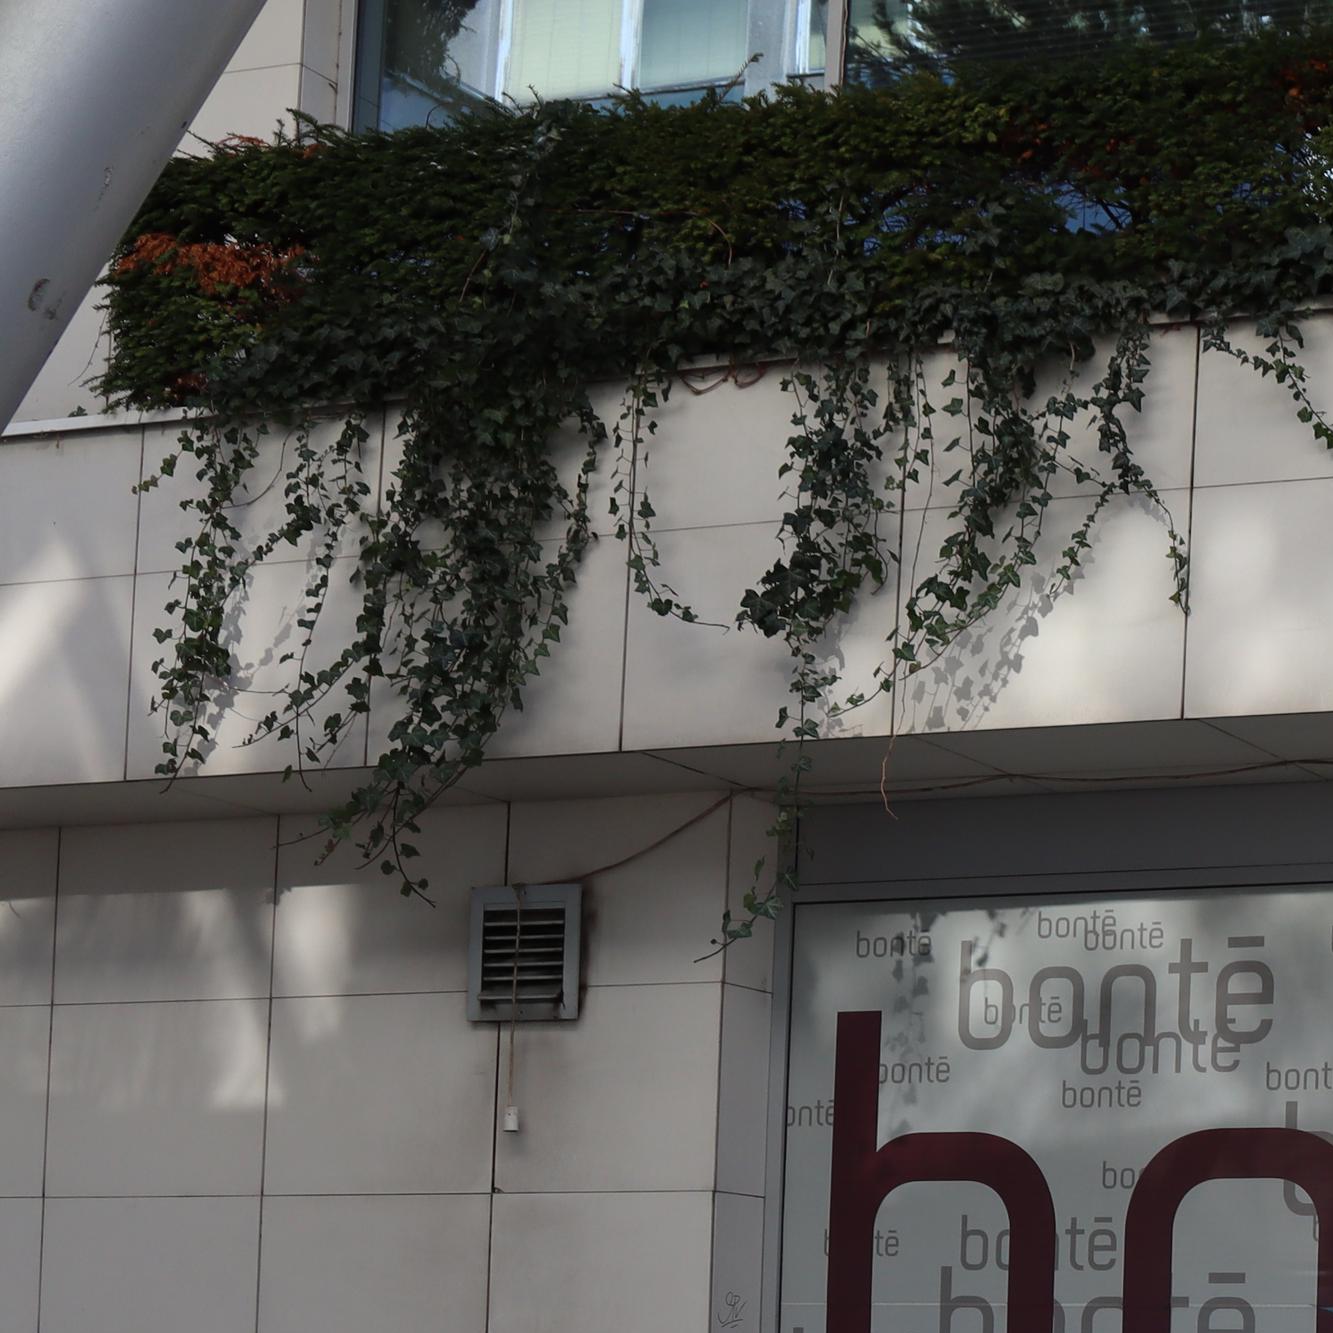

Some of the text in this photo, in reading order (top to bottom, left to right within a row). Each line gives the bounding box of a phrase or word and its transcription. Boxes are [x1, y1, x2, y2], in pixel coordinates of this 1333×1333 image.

[1038, 909, 1117, 938] bontē
[1084, 922, 1164, 951] bontē
[857, 931, 932, 958] bontē
[959, 936, 1274, 1050] bontē
[1061, 1079, 1141, 1108] bontē
